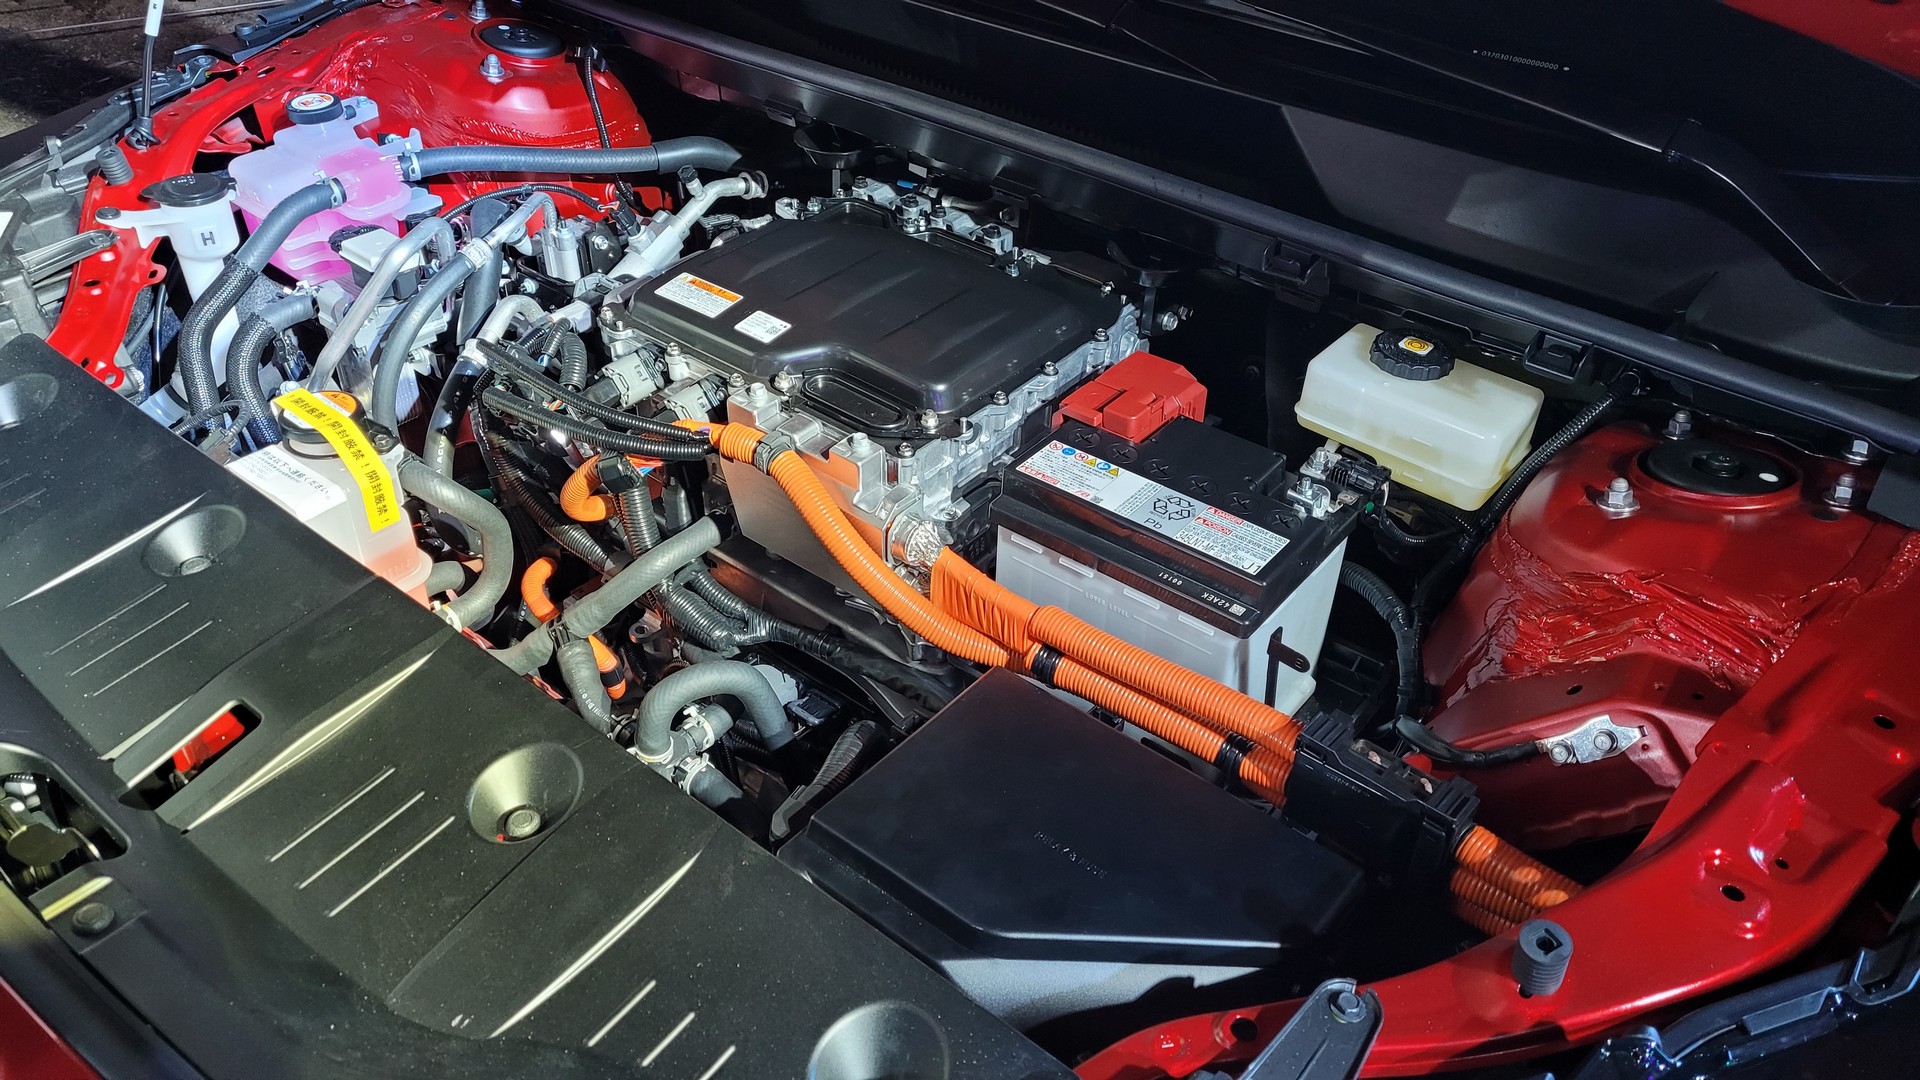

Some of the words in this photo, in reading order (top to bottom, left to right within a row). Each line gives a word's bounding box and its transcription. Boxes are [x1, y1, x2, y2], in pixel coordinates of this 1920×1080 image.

[201, 231, 216, 246] H
[1144, 517, 1163, 530] Pb
[1204, 520, 1232, 534] POISON
[1215, 510, 1243, 524] DANGER
[1242, 521, 1269, 536] EXPLOSIVE
[1268, 534, 1288, 544] GASES
[1241, 562, 1262, 573] J1
[1109, 603, 1130, 617] LEVEL
